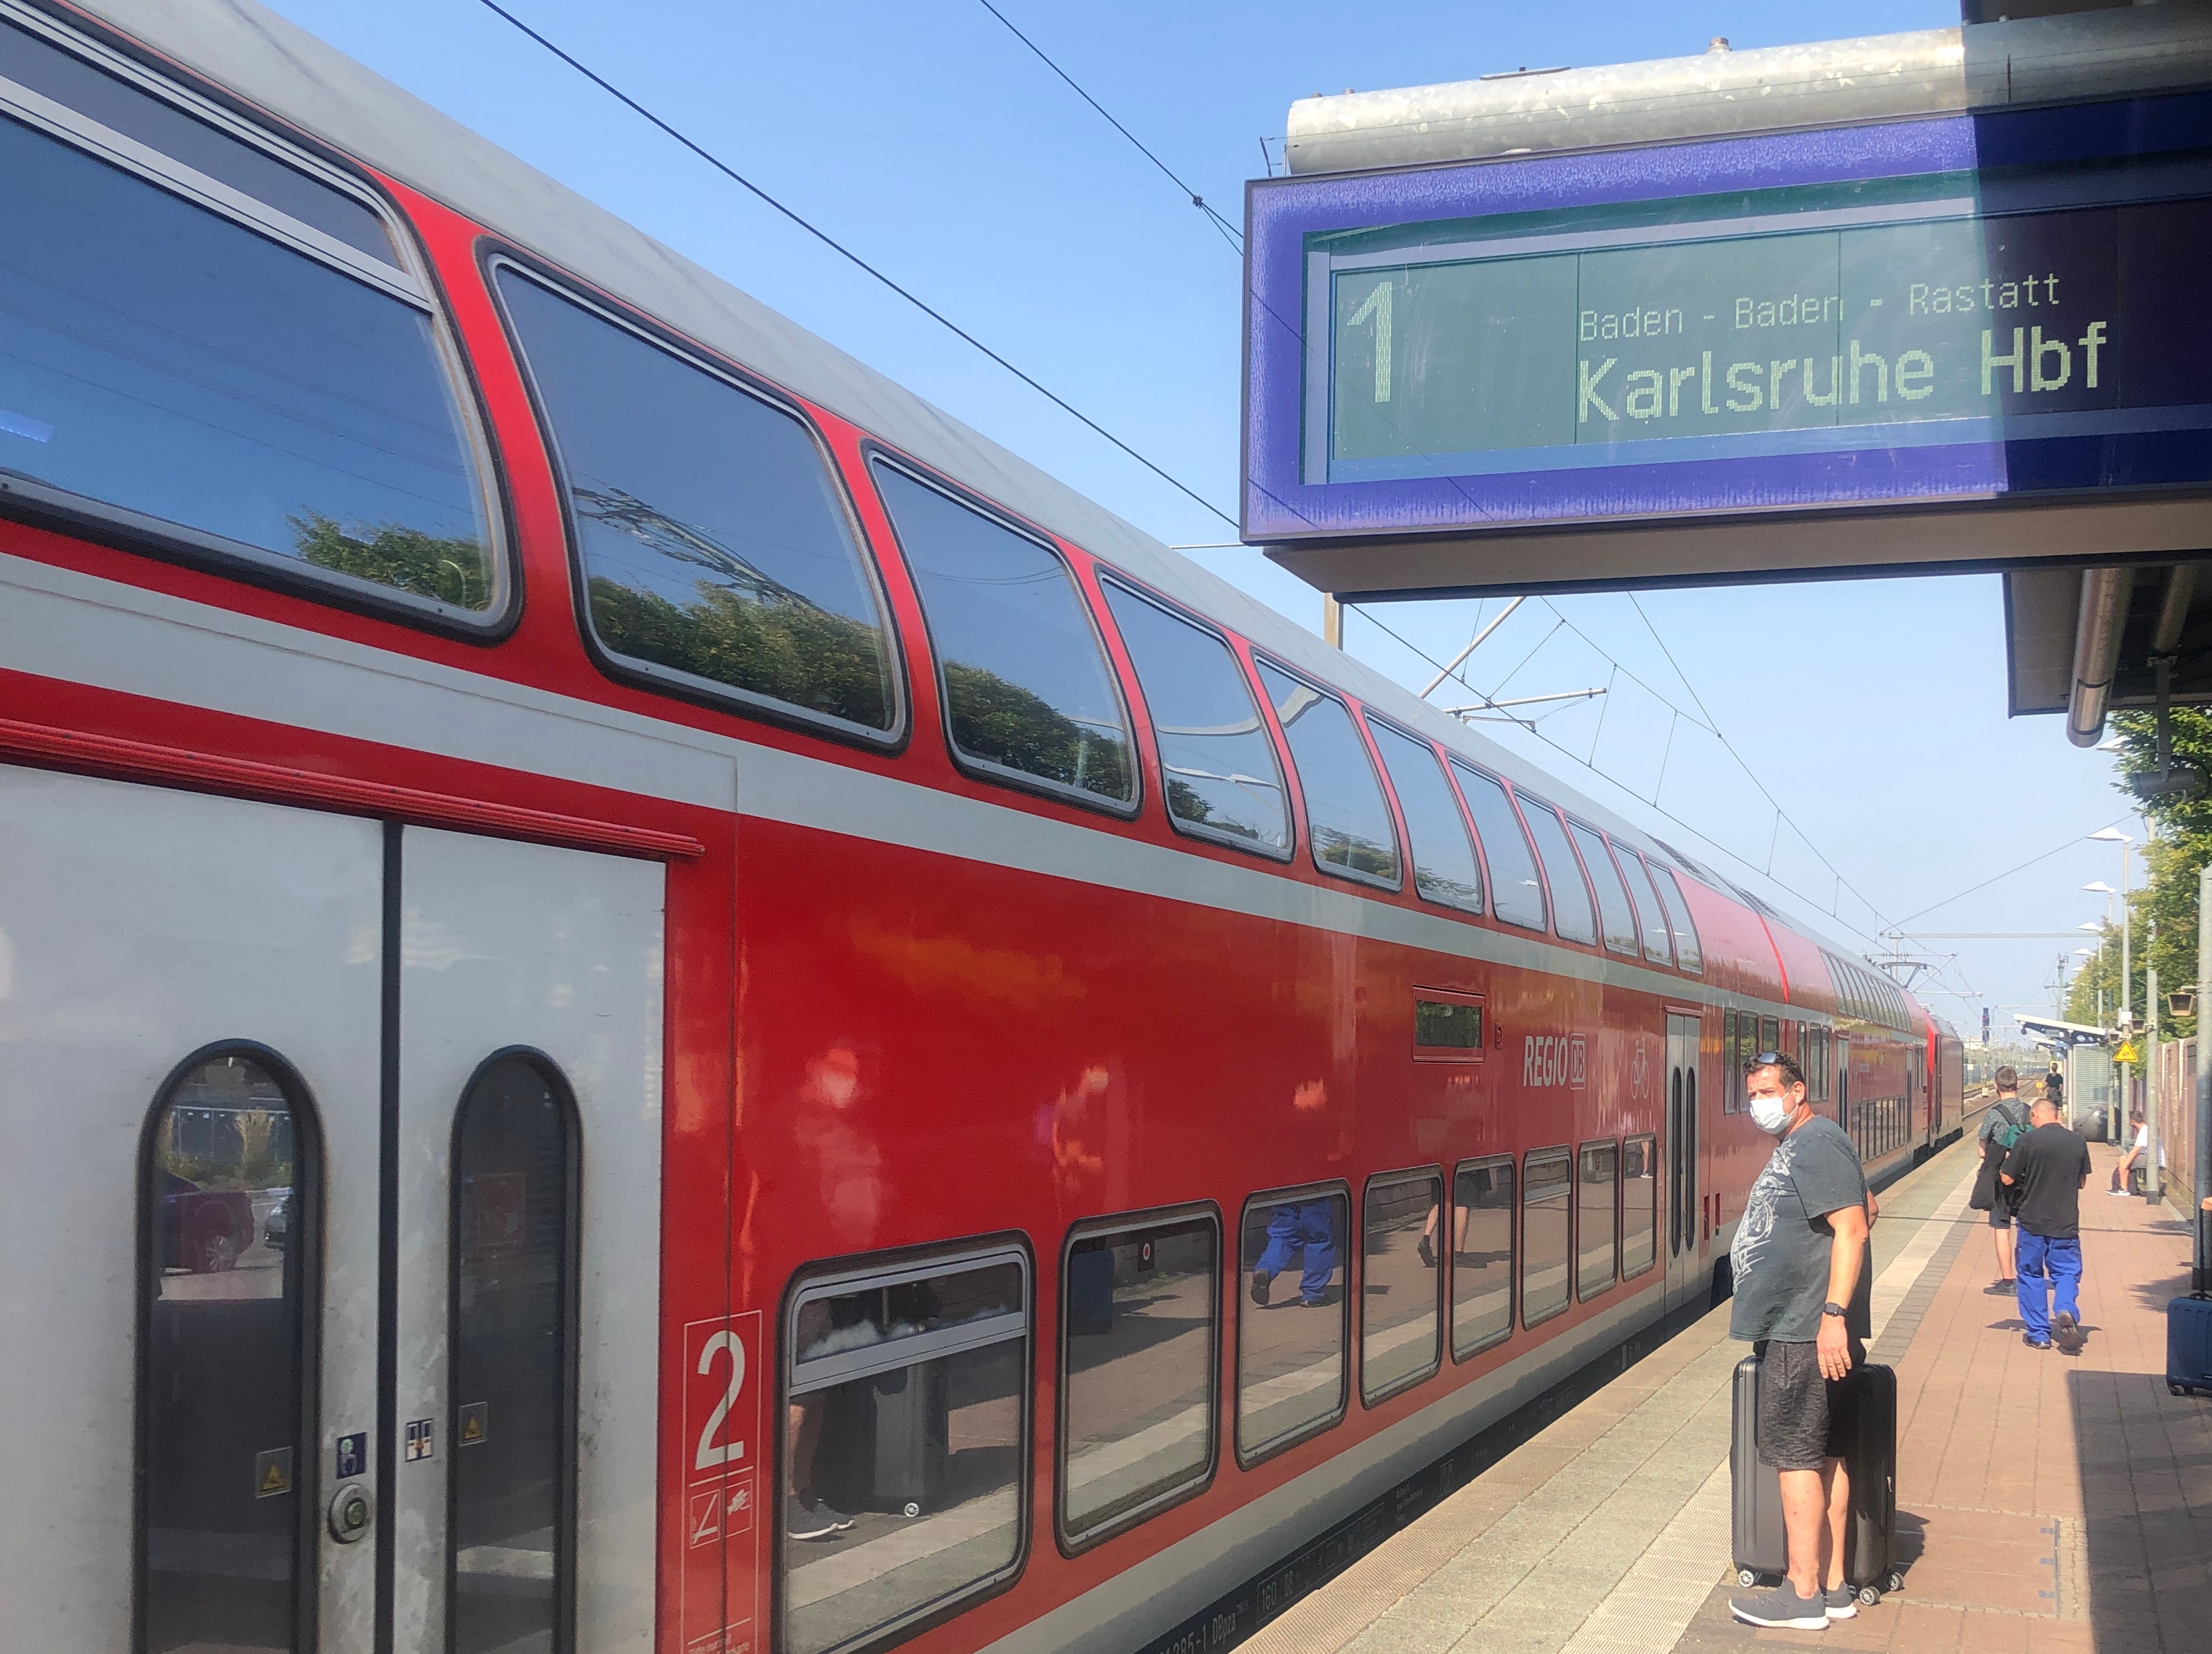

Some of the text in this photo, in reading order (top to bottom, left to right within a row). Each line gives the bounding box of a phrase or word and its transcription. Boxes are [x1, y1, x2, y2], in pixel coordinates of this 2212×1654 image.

[1346, 281, 1392, 403] 1
[1580, 306, 1683, 341] Baden
[1734, 294, 1844, 329] Baden
[1909, 273, 2060, 315] Rastatt
[1578, 321, 2107, 423] Karlsruhe Hbf
[1523, 1035, 1568, 1087] REGIO
[694, 1330, 746, 1471] 2
